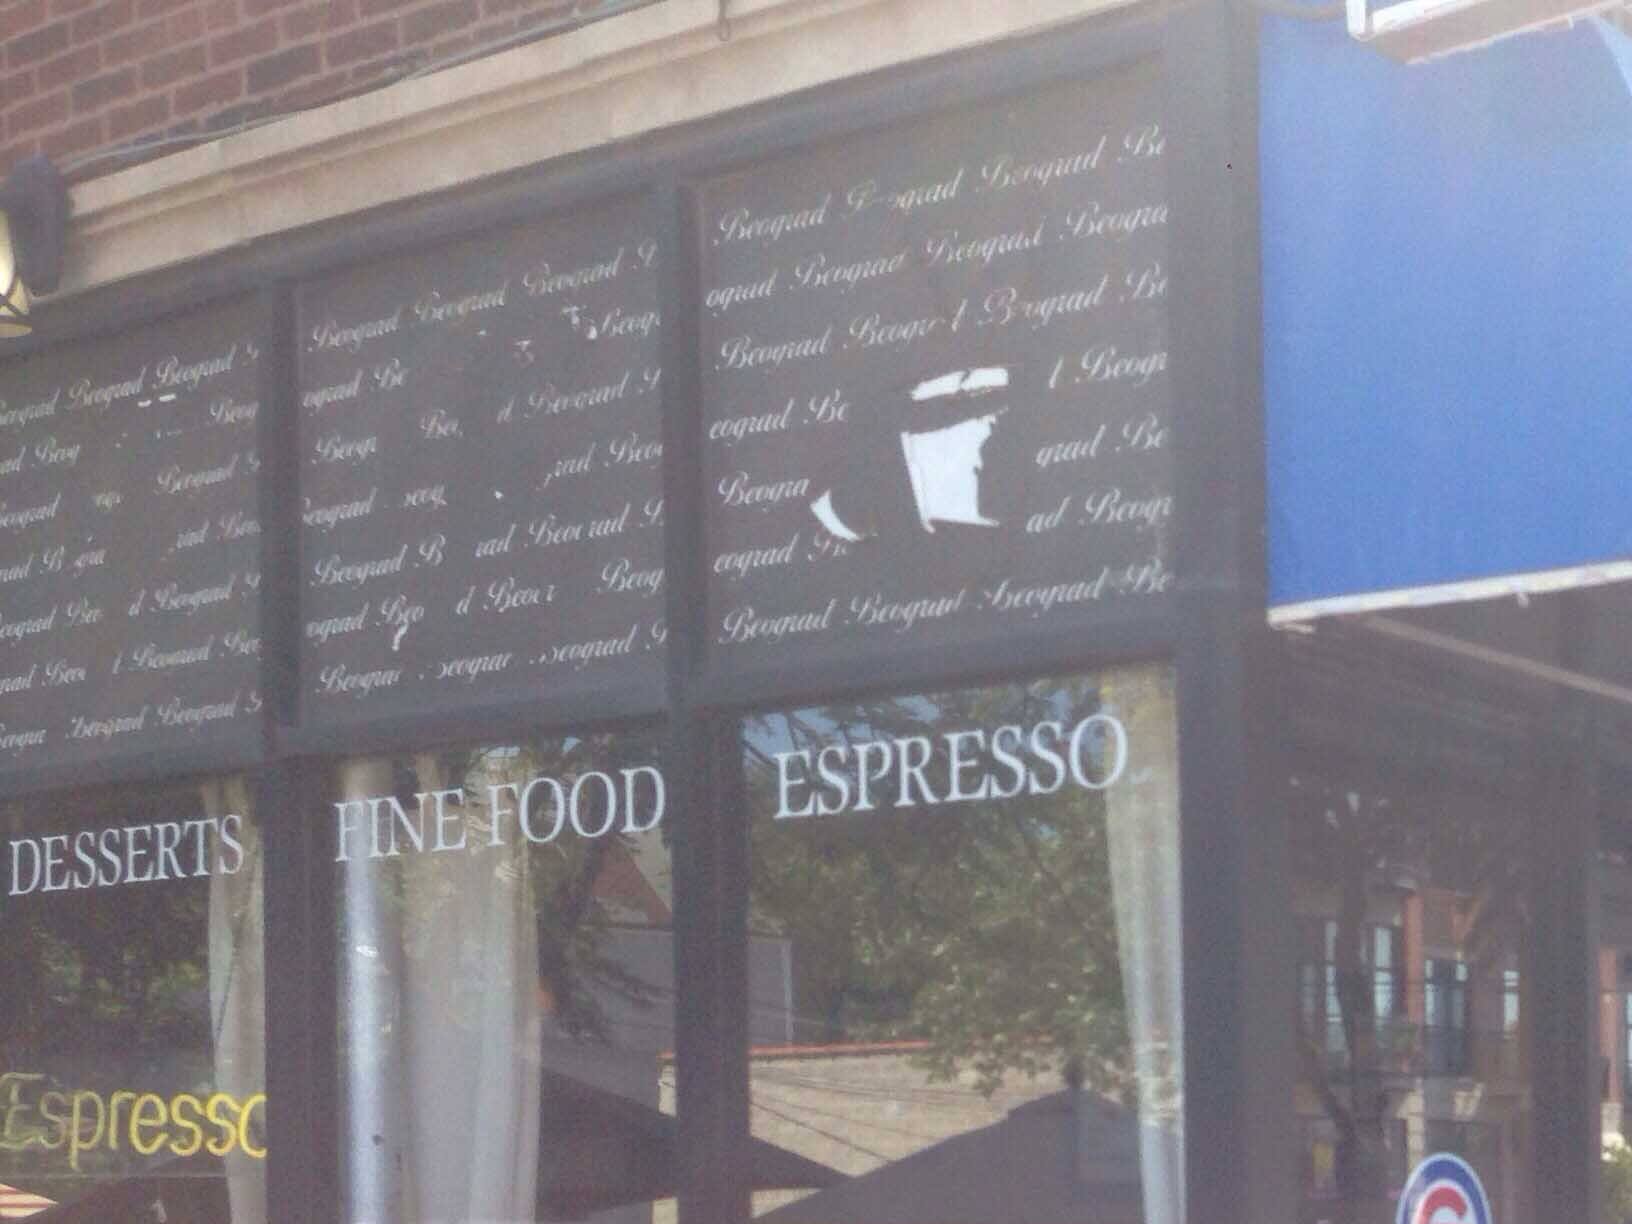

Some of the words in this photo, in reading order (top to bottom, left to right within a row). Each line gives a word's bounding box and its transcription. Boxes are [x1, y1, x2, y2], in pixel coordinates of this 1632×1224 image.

[334, 787, 467, 863] FINE
[486, 765, 666, 848] FOOD
[774, 714, 1129, 820] ESPRESSO
[8, 815, 244, 896] DESSERTS
